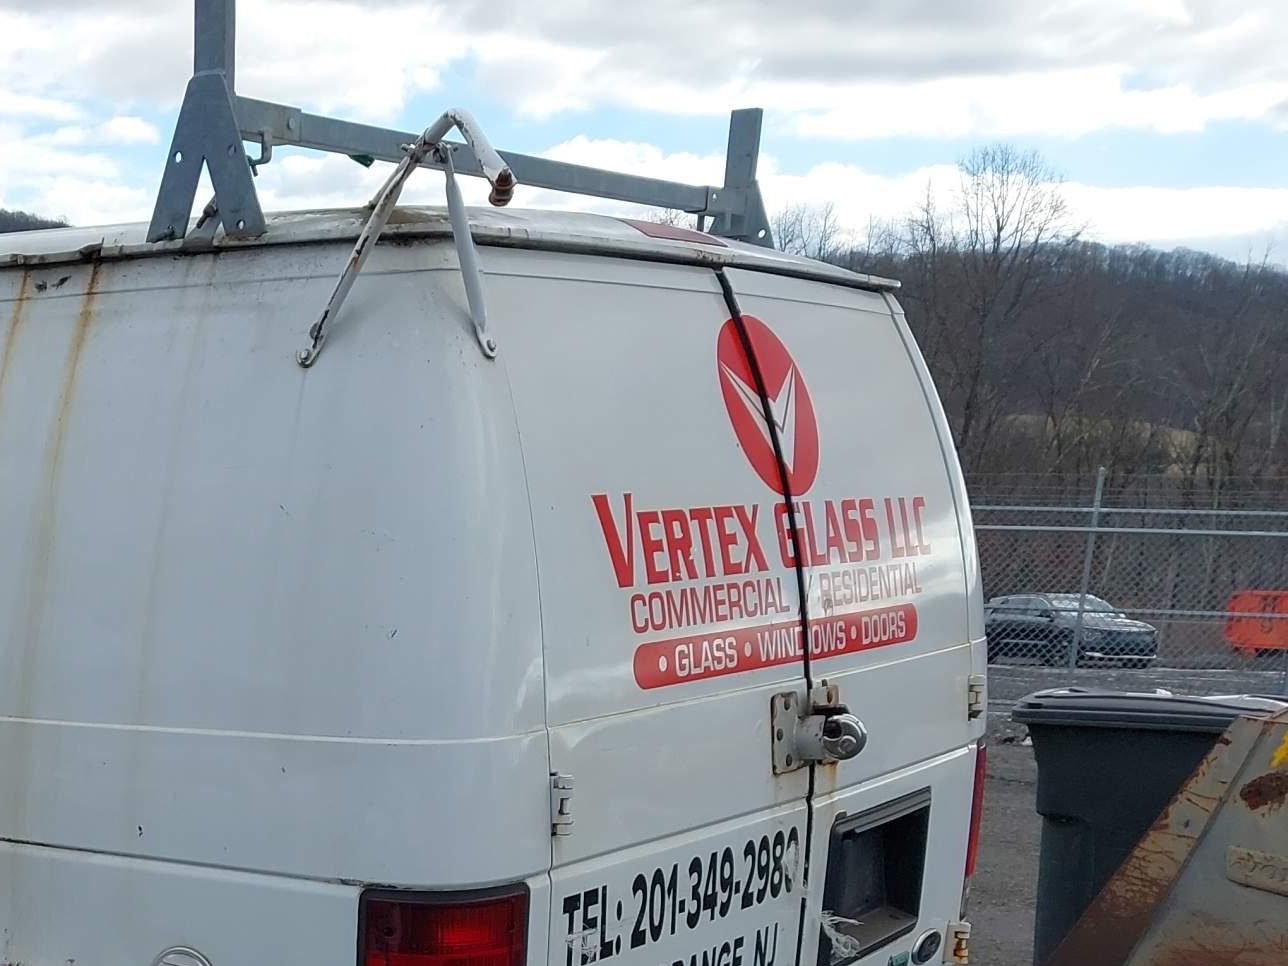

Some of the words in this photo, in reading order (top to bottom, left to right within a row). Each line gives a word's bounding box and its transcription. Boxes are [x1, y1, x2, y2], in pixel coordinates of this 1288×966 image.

[592, 492, 770, 588] VERTEX
[773, 498, 881, 568] GLASS
[884, 497, 931, 559] LLC
[630, 577, 791, 633] COMMERCIAL
[819, 563, 922, 609] RESIDENTIAL
[674, 639, 738, 676] GLASS
[862, 610, 905, 642] DOORS
